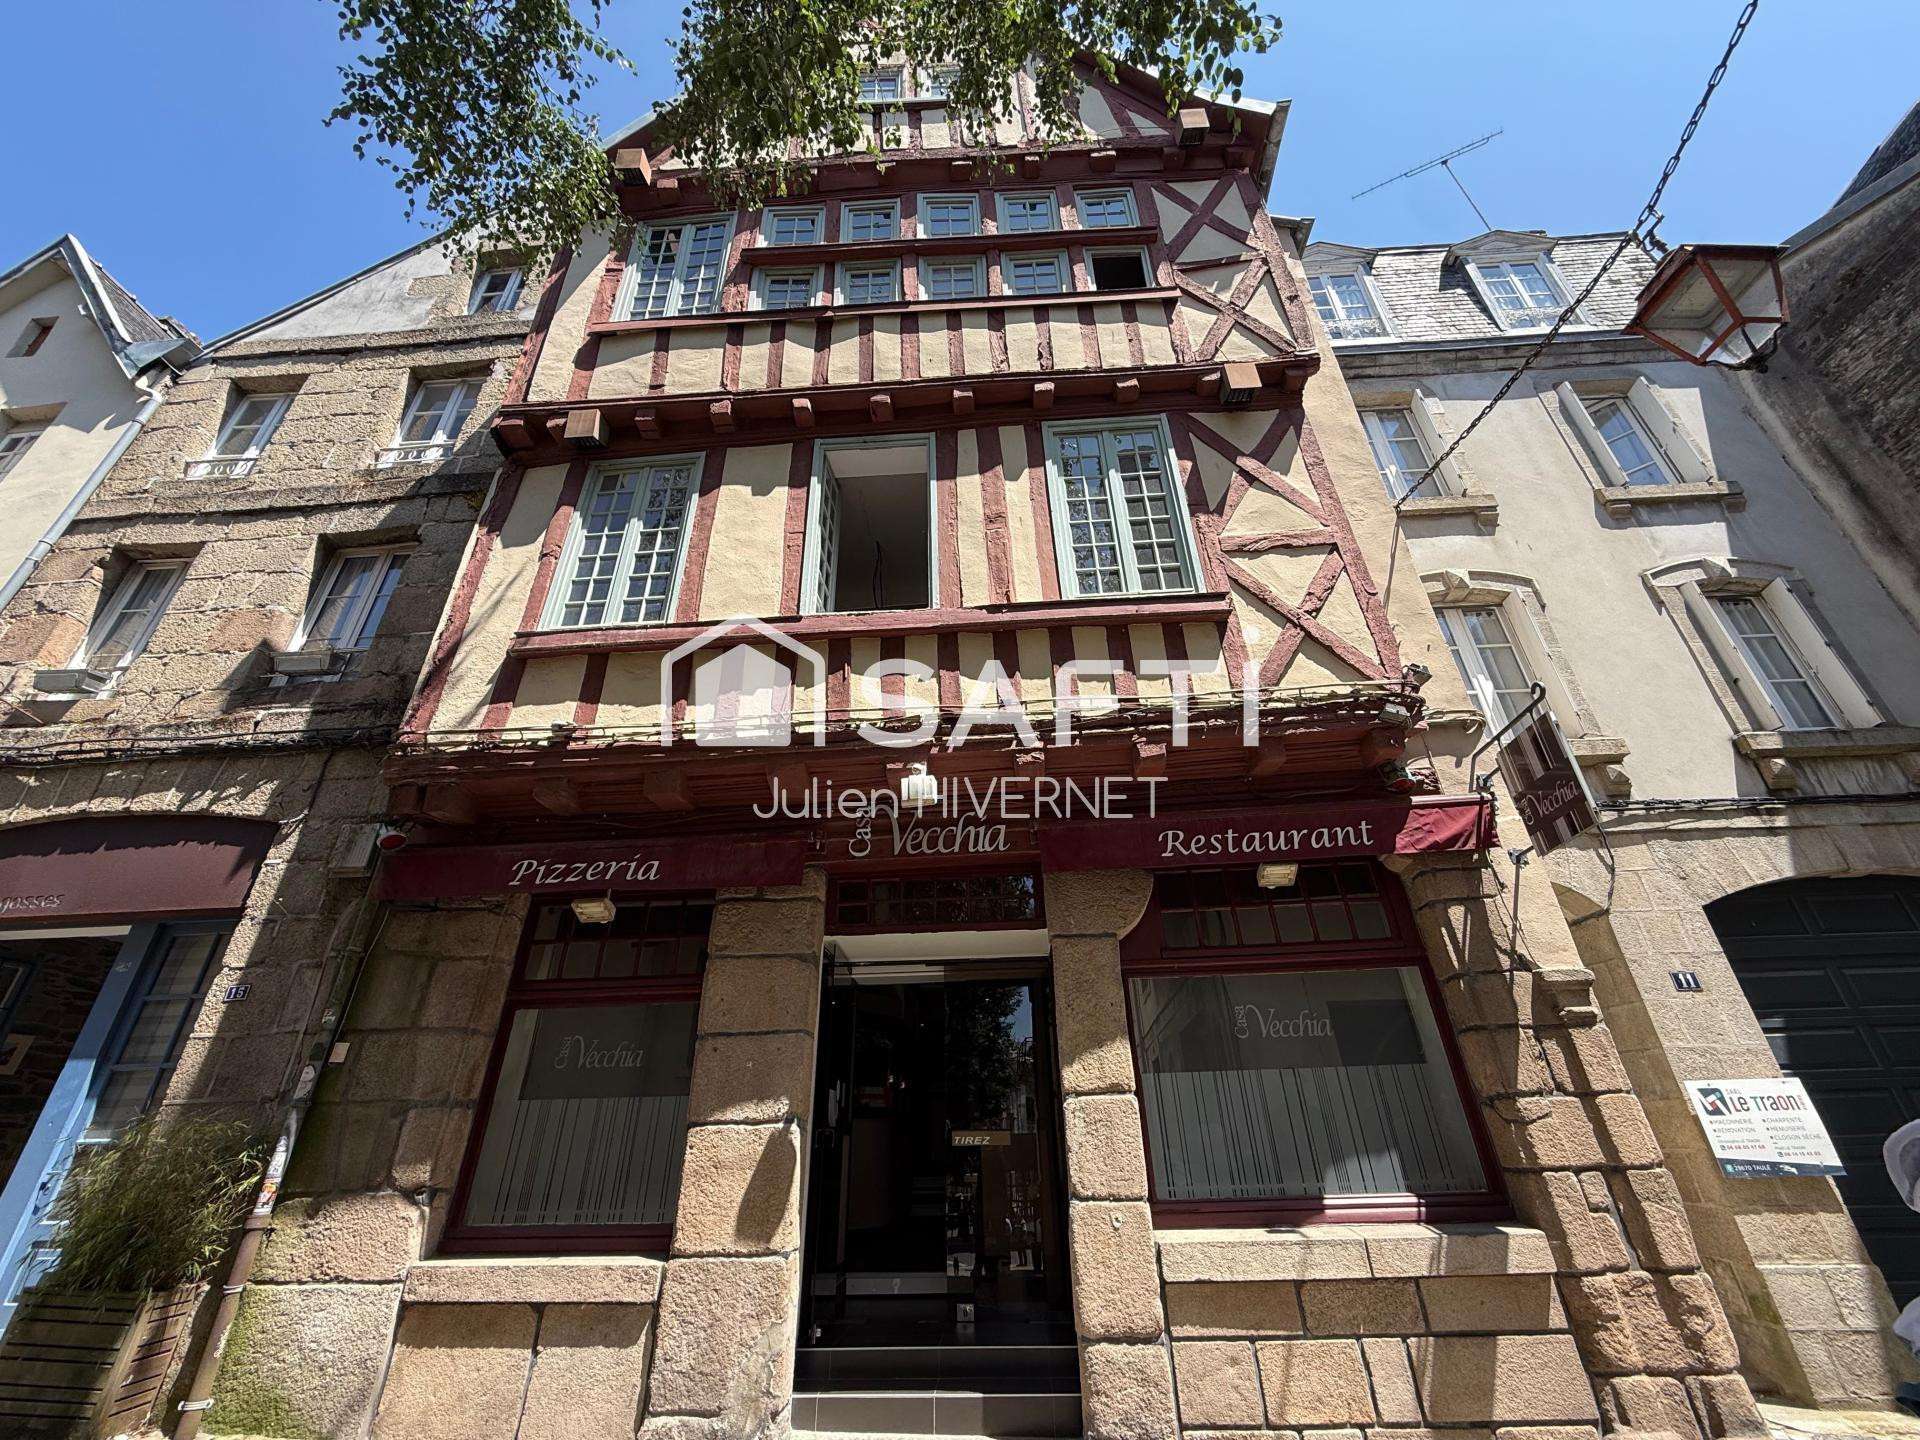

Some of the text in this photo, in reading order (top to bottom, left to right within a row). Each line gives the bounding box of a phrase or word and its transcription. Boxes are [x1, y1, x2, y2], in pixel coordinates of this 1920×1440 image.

[1526, 780, 1579, 818] Vecchia
[848, 804, 1011, 857] Casa Vecchia
[1158, 819, 1375, 857] Restaurant
[508, 853, 662, 886] Pizzeria
[230, 986, 245, 998] 15
[1678, 973, 1697, 988] 11
[1245, 1004, 1335, 1038] Vecchia
[573, 1035, 644, 1069] Vecchia
[954, 1136, 991, 1145] TIREZ
